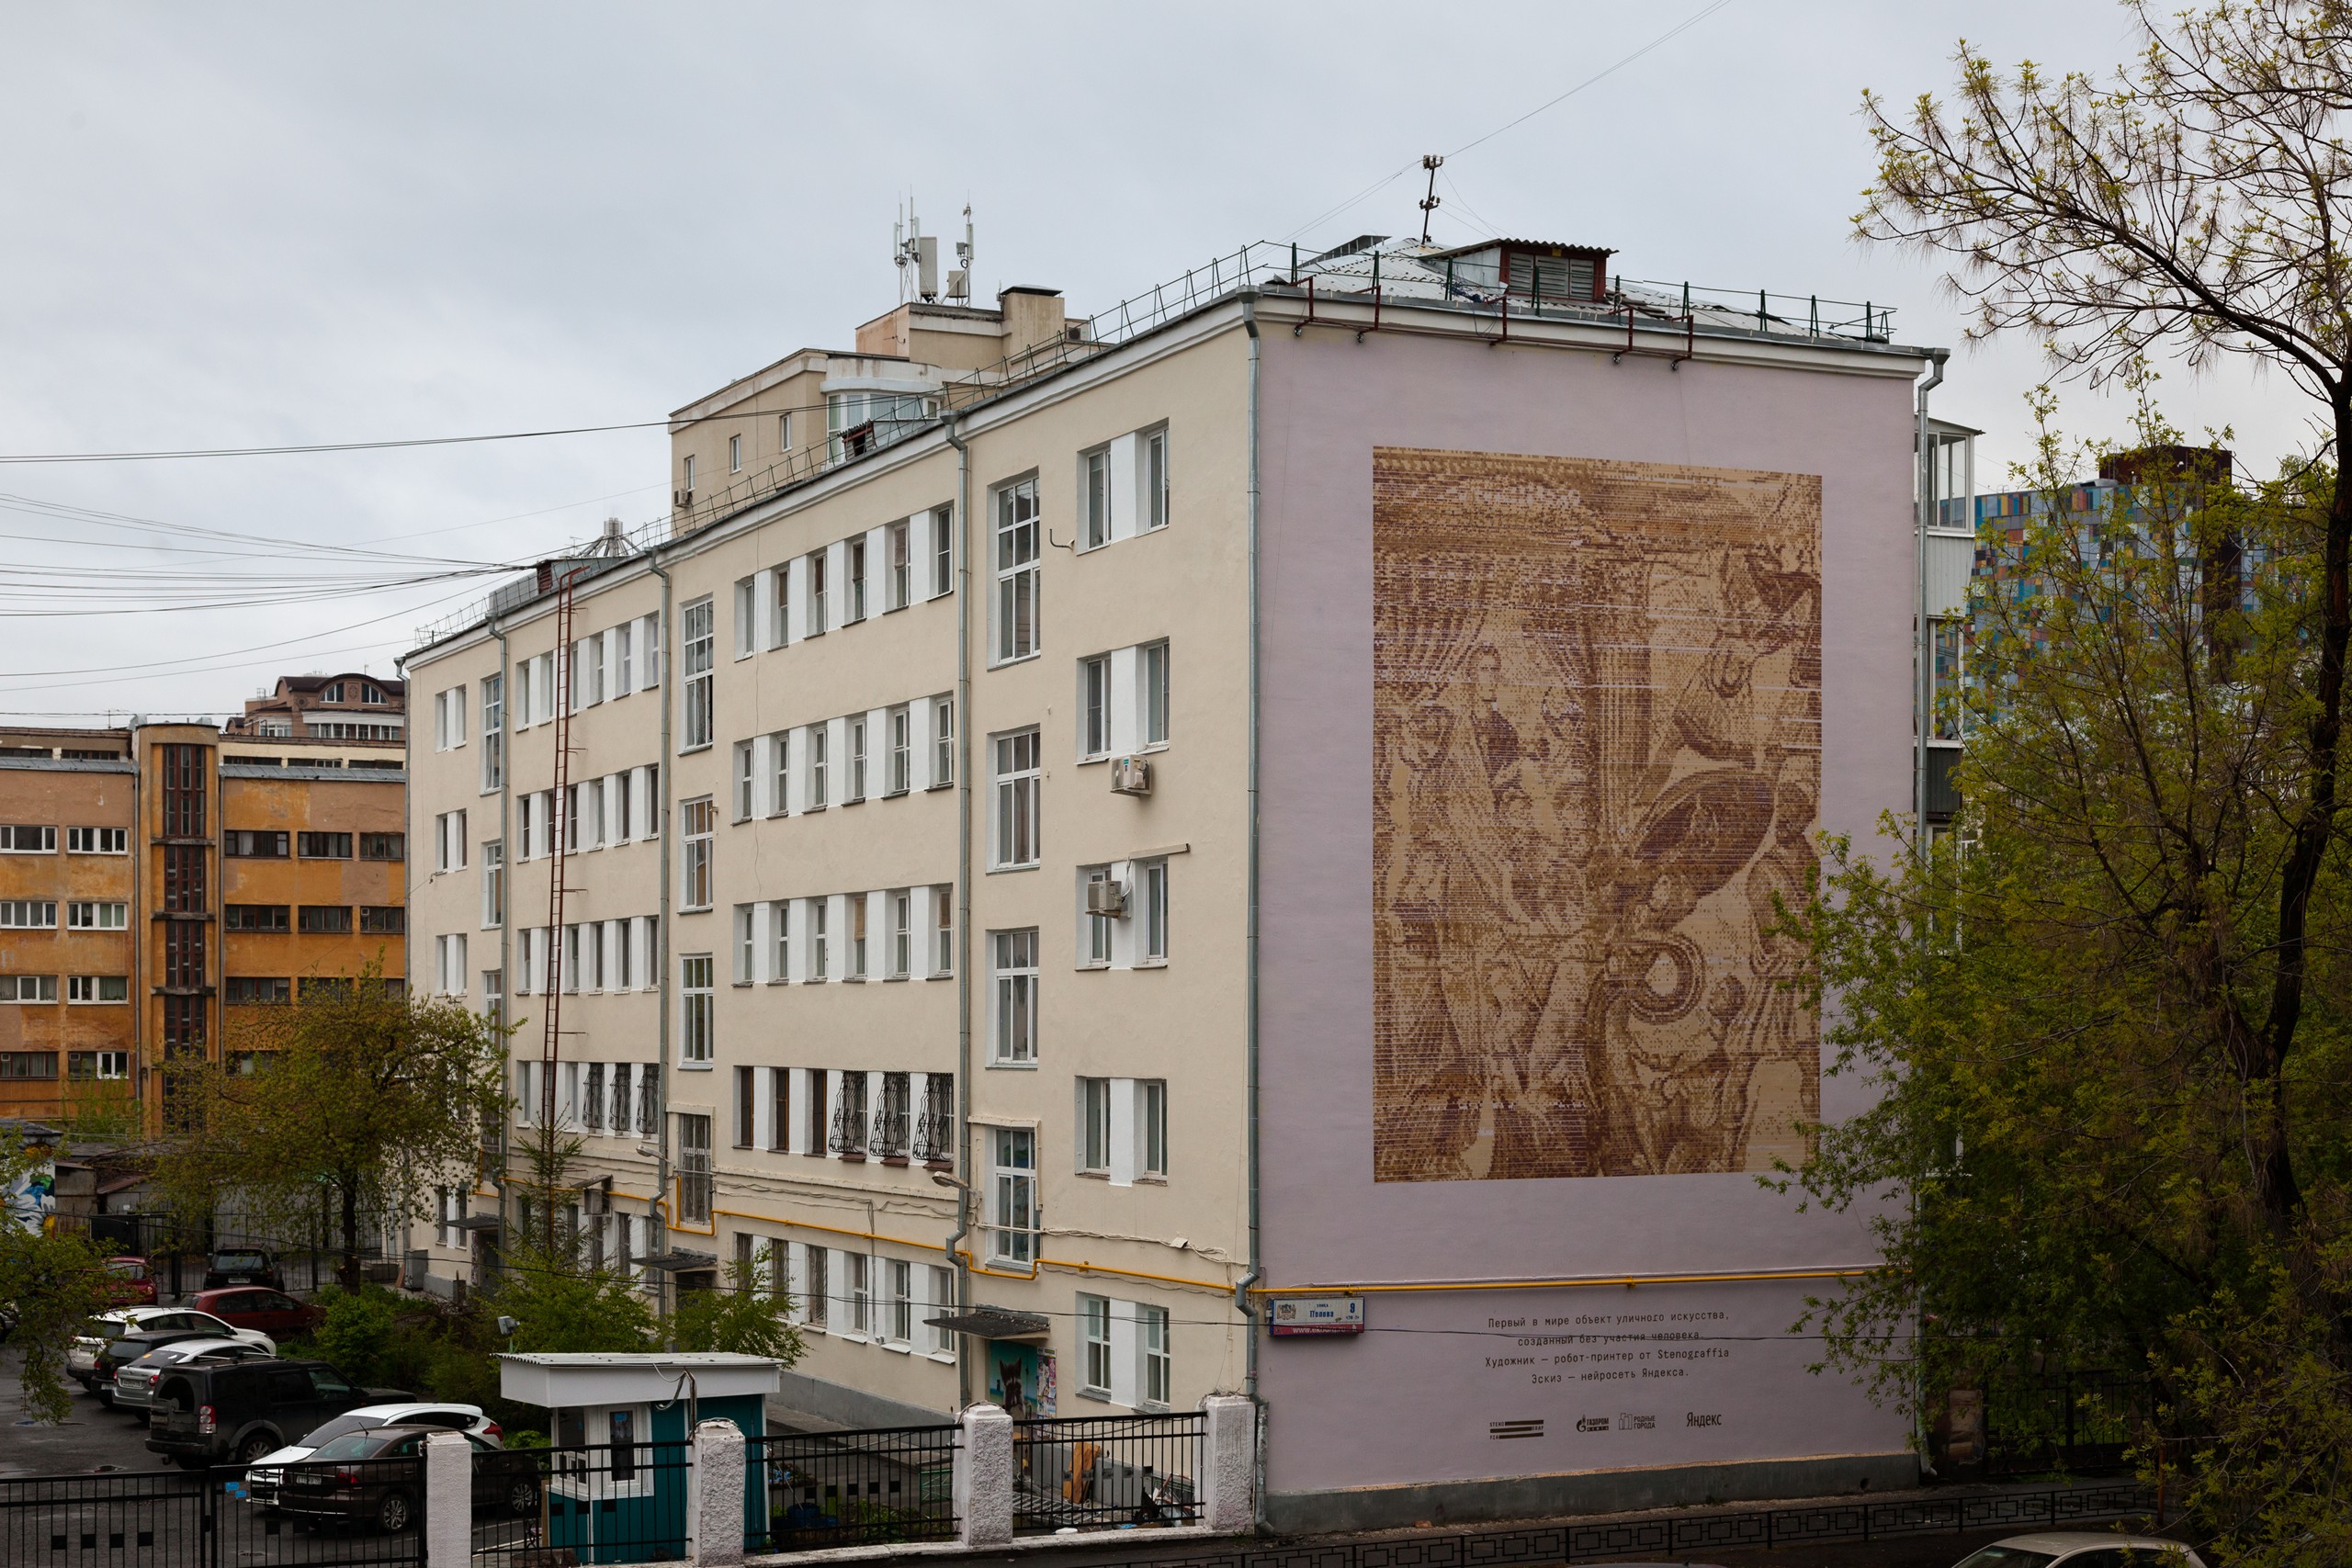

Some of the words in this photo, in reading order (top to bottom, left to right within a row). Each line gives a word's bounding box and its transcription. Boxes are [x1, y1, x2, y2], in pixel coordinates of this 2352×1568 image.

[1309, 1310, 1334, 1318] Попова
[1350, 1303, 1355, 1314] 9
[1488, 1317, 1526, 1329] Первый
[1544, 1317, 1569, 1327] мире
[1575, 1314, 1611, 1325] объект
[1616, 1314, 1665, 1325] уличного
[1518, 1335, 1574, 1347] созданный
[1579, 1334, 1597, 1344] без
[1603, 1334, 1645, 1345] участия
[1485, 1357, 1535, 1369] Художник
[1554, 1352, 1634, 1365] робот-принтер
[1639, 1351, 1651, 1360] от
[1657, 1348, 1729, 1360] Stenograffia
[1532, 1373, 1562, 1384] Эскиз
[1581, 1370, 1636, 1382] нейросеть
[1642, 1368, 1689, 1378] Яндекса.
[1587, 1417, 1610, 1426] ГАЗПРОМ
[1634, 1415, 1656, 1423] РОДНЫЕ
[1686, 1412, 1722, 1427] Яндекс
